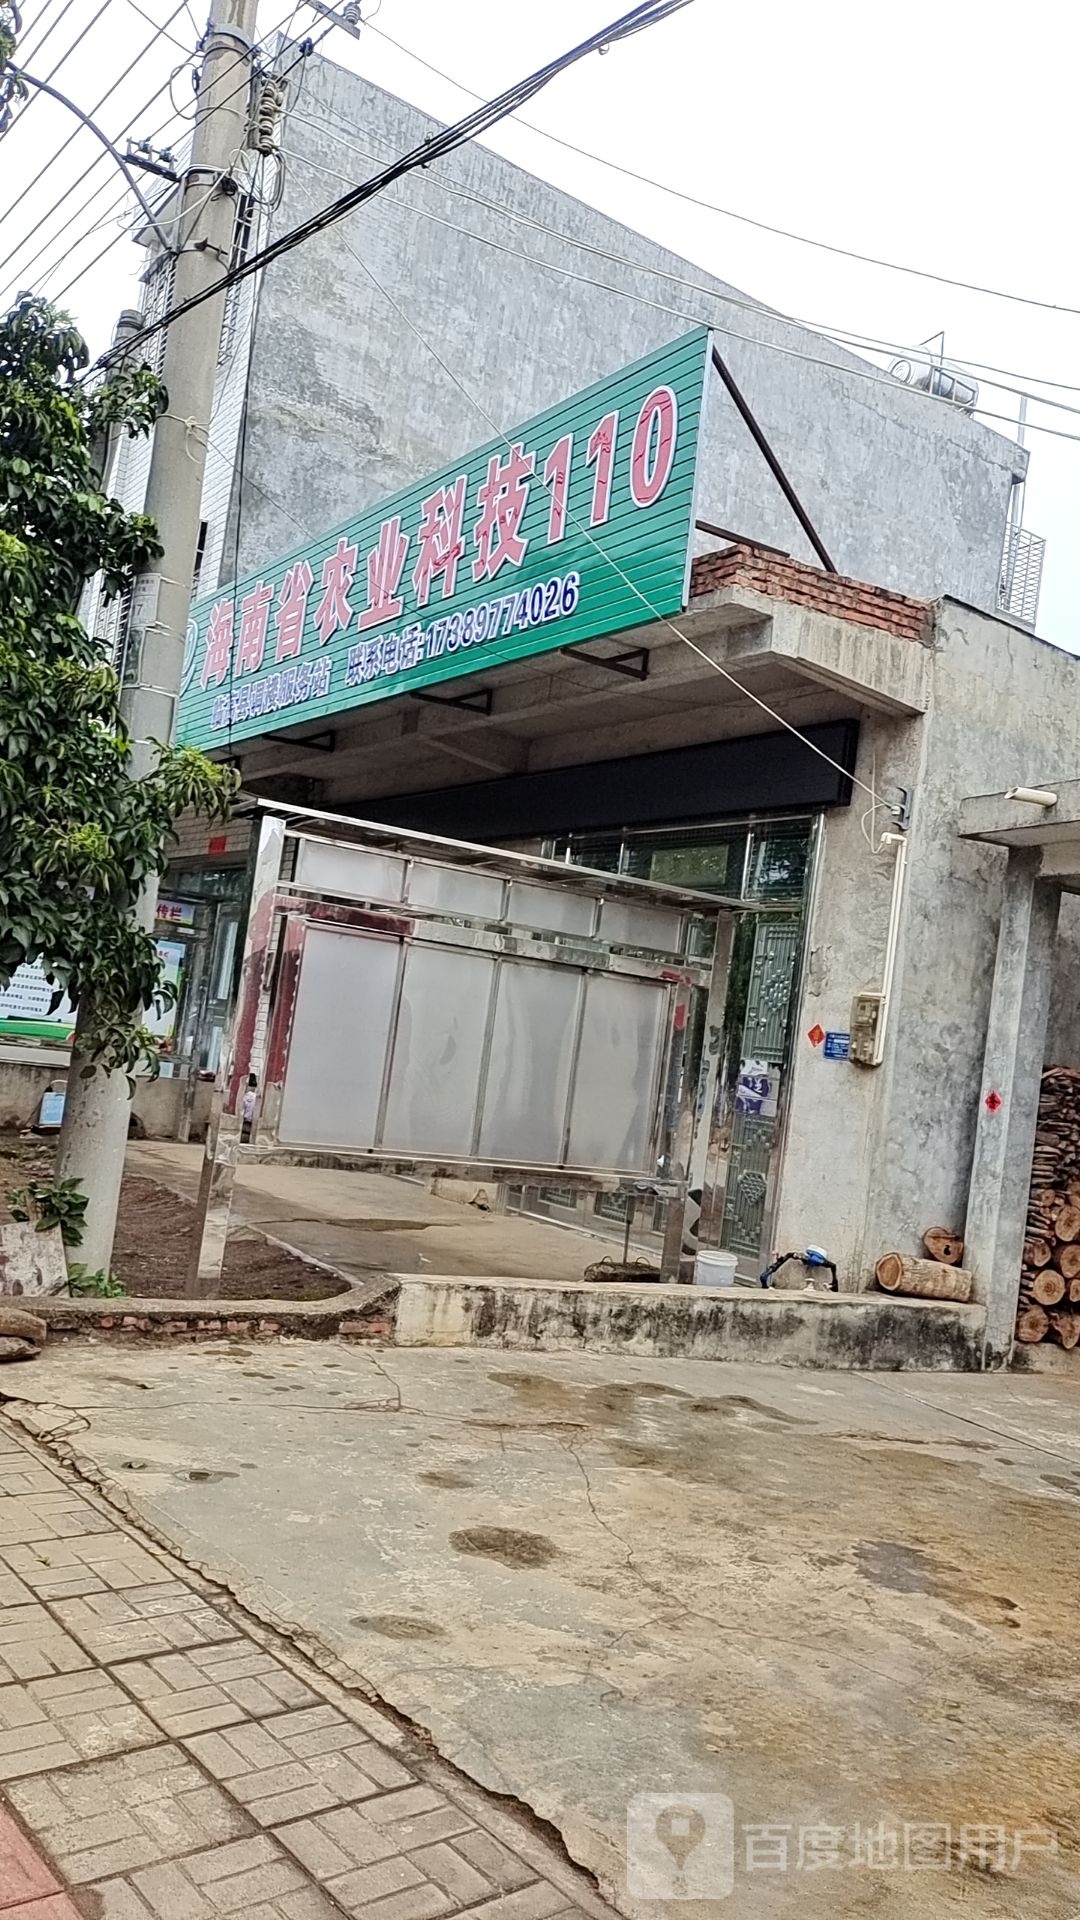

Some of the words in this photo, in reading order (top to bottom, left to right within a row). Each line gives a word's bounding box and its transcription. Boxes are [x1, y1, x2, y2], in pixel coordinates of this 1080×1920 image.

[200, 384, 680, 690] 海南省农业科技110
